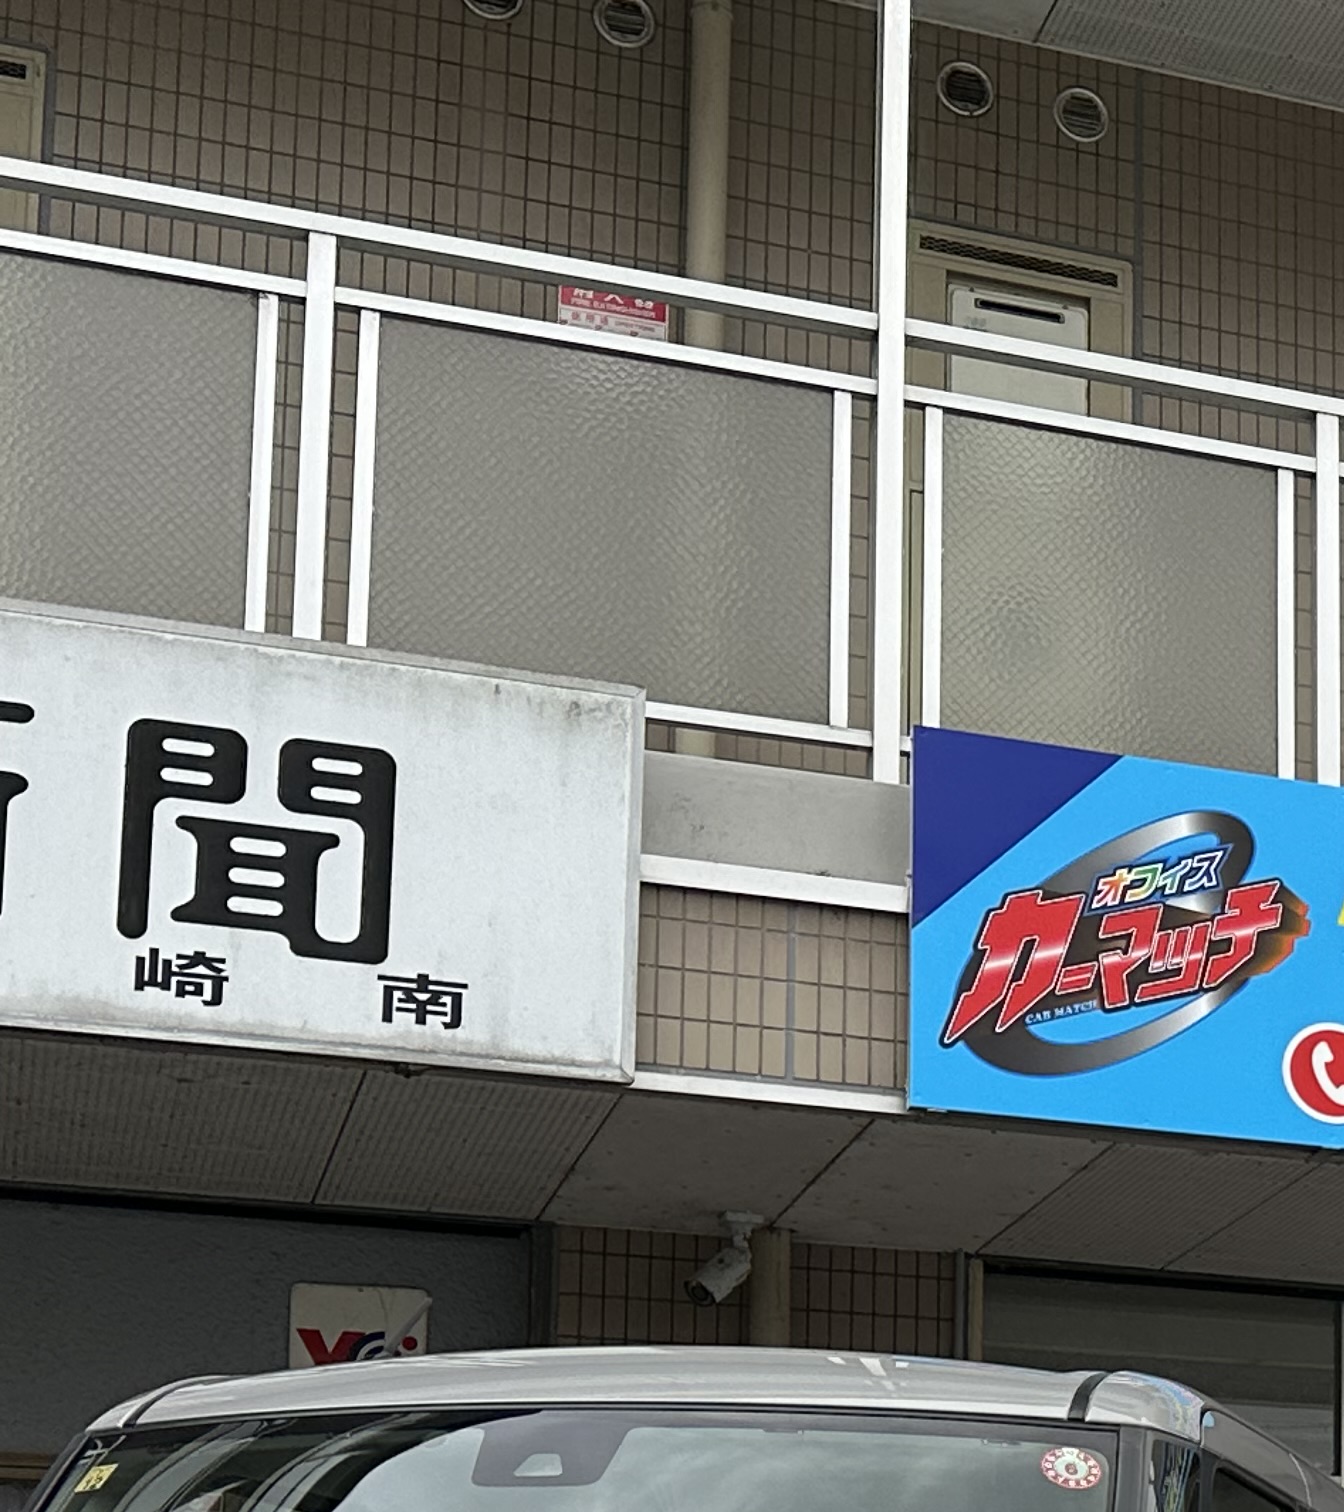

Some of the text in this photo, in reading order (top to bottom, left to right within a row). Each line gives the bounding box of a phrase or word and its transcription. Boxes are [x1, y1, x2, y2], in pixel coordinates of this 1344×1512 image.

[944, 881, 1283, 1043] カーマッチ
